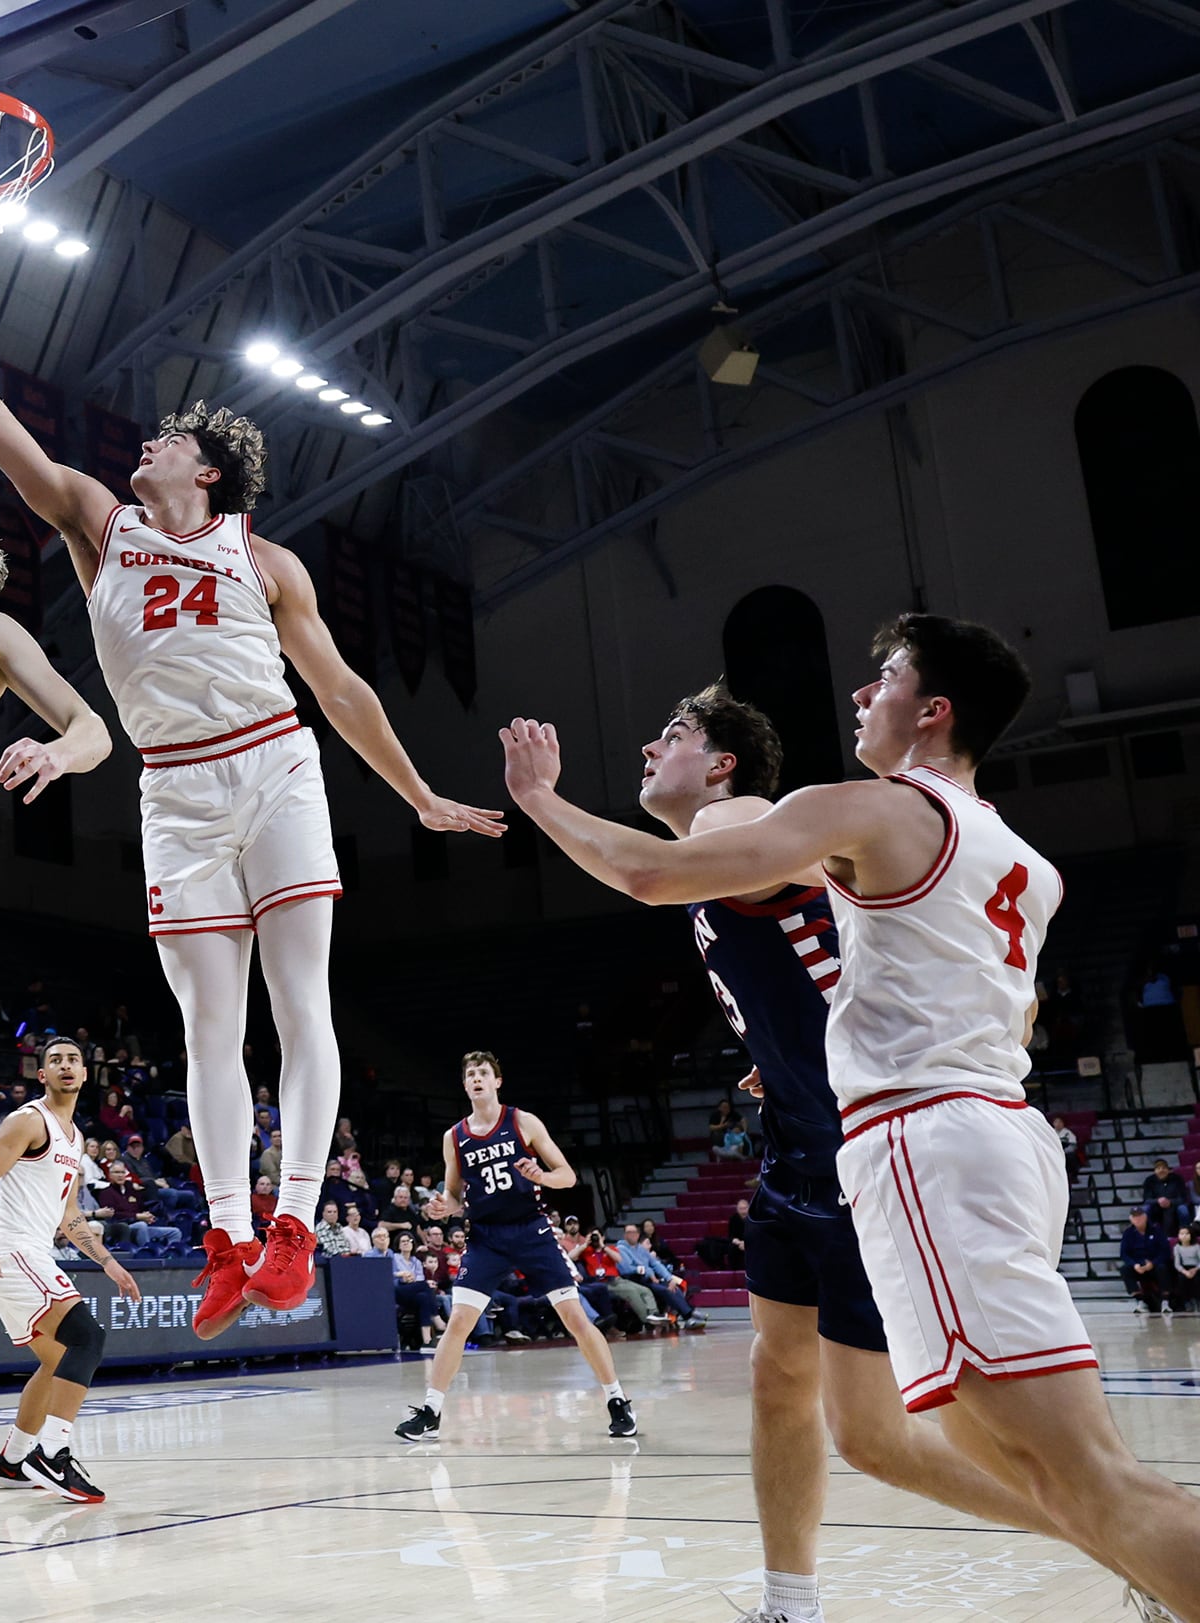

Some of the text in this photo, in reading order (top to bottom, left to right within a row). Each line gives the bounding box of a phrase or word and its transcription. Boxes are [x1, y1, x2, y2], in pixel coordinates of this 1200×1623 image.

[217, 544, 232, 554] Ivy
[120, 550, 242, 583] CORNELL
[143, 575, 220, 632] 24
[148, 885, 165, 914] C
[984, 862, 1029, 971] 4
[464, 1140, 516, 1167] PENN
[61, 1172, 73, 1201] 7
[481, 1161, 513, 1194] 35
[55, 1274, 71, 1288] C
